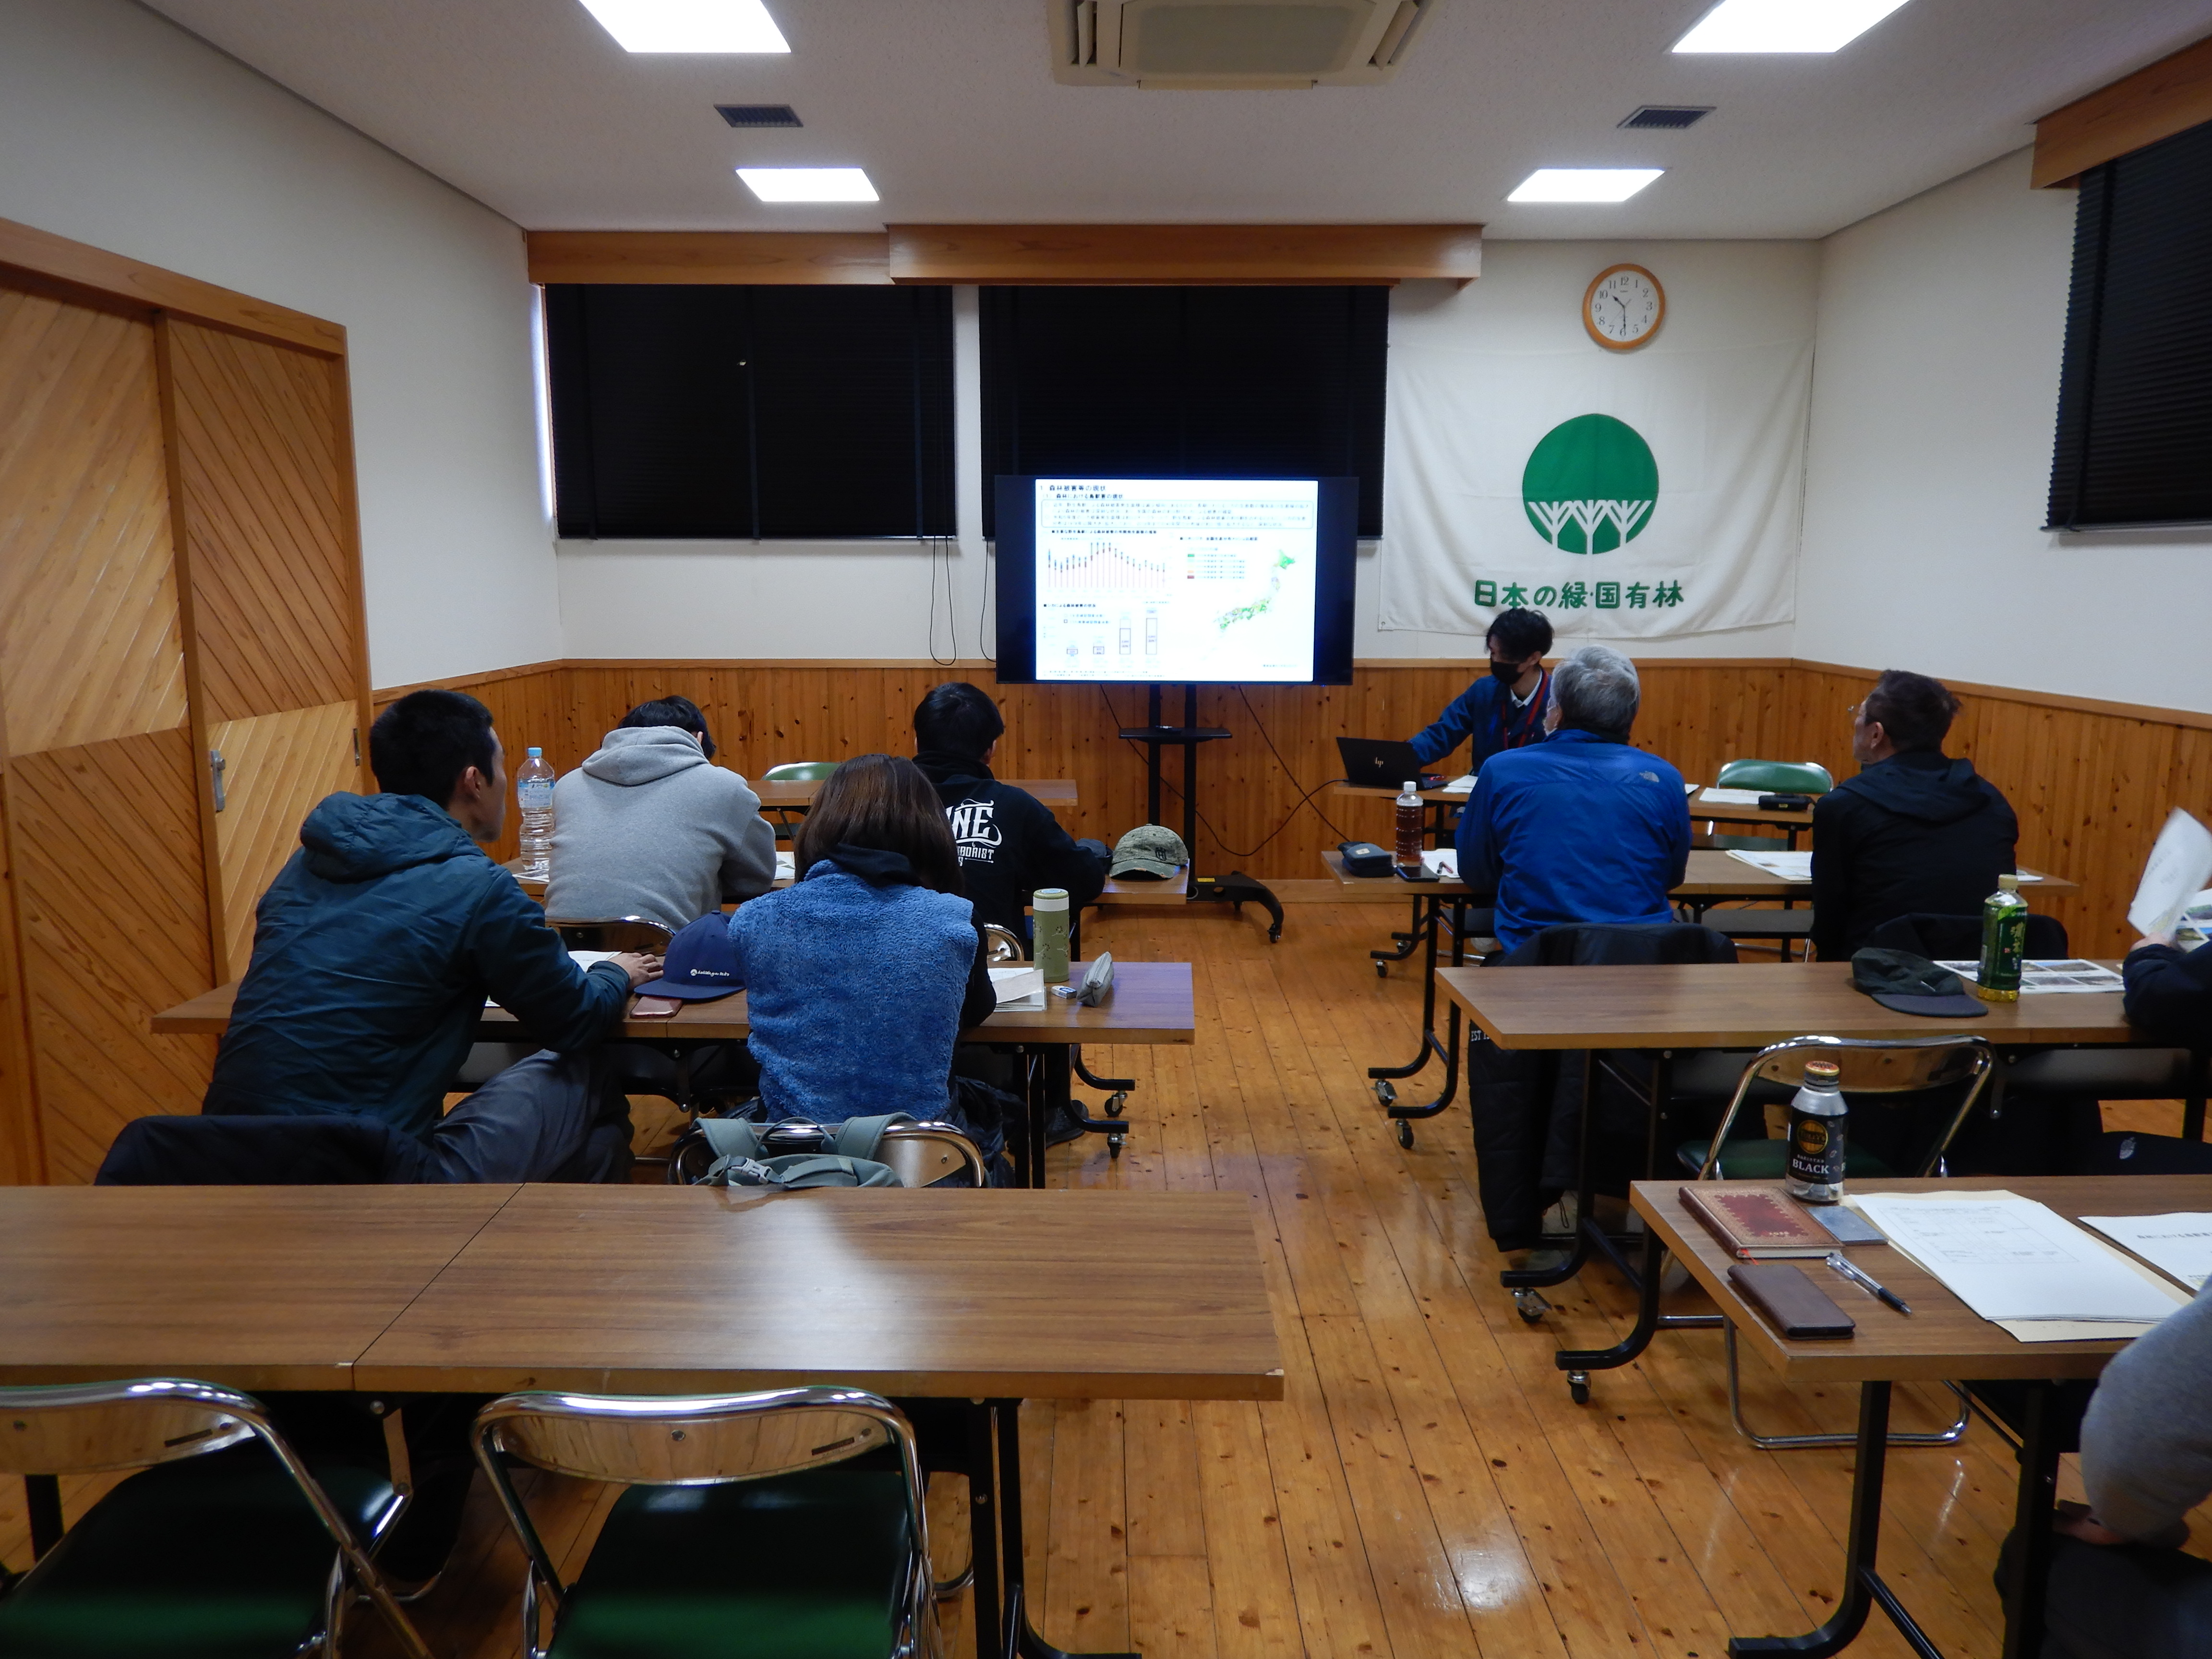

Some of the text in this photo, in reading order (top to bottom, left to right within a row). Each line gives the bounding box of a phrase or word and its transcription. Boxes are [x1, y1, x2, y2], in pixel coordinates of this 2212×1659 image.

[1609, 280, 1616, 289] 11
[1620, 276, 1629, 286] 12
[1635, 279, 1638, 288] 1
[1599, 290, 1608, 299] 10
[1643, 289, 1648, 298] 2
[1595, 303, 1601, 312] 9
[1646, 301, 1652, 311] 3
[1599, 316, 1605, 325] 8
[1641, 315, 1647, 323] 4
[1609, 325, 1614, 334] 7
[1620, 327, 1626, 336] 6
[1633, 325, 1638, 333] 5
[1475, 579, 1684, 609] 日本の緑・国有林
[1375, 757, 1383, 768] hp
[1792, 1158, 1829, 1174] BLACK
